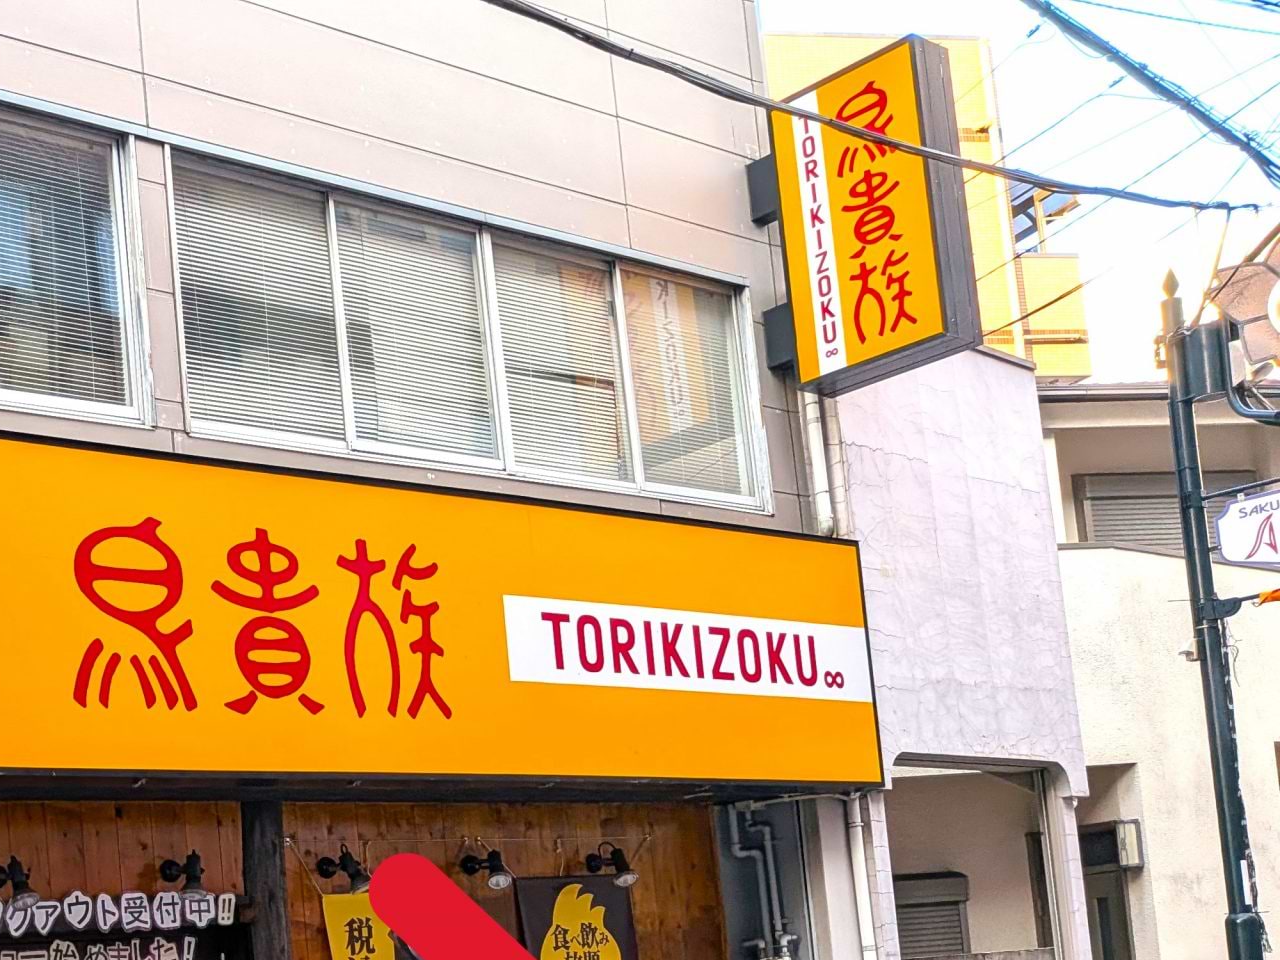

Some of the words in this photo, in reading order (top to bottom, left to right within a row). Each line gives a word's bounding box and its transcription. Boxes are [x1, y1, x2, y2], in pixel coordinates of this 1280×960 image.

[798, 115, 837, 344] TORIKIZOKU
[73, 516, 451, 719] 鳥貴族
[541, 611, 818, 688] TORIKIZOKU
[551, 922, 610, 951] 食べ飲み
